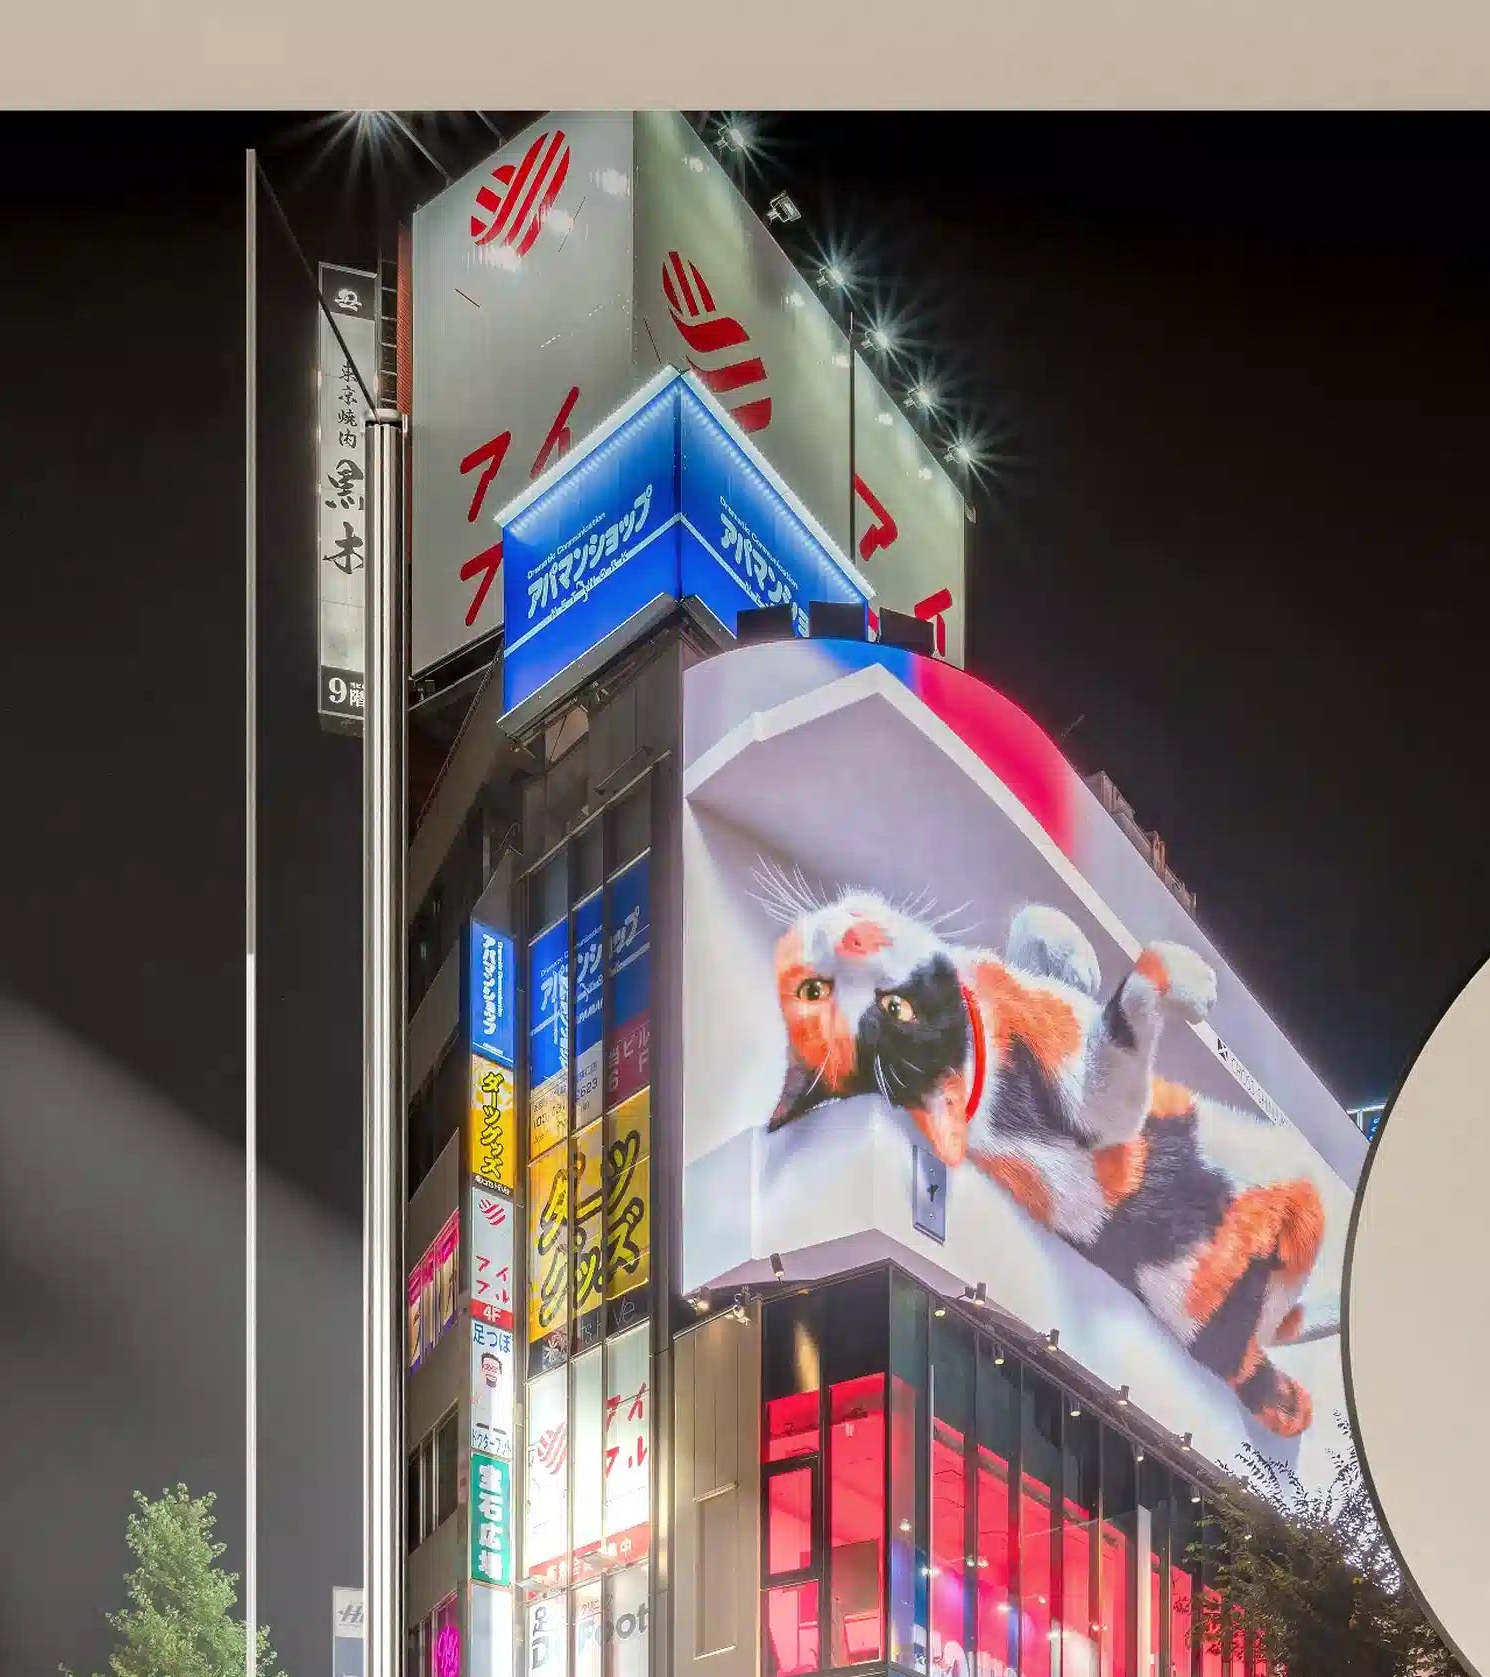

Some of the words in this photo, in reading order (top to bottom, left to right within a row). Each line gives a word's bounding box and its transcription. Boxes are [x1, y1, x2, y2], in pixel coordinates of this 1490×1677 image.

[526, 482, 653, 620] アパマンショップ
[482, 1308, 502, 1324] 4F
